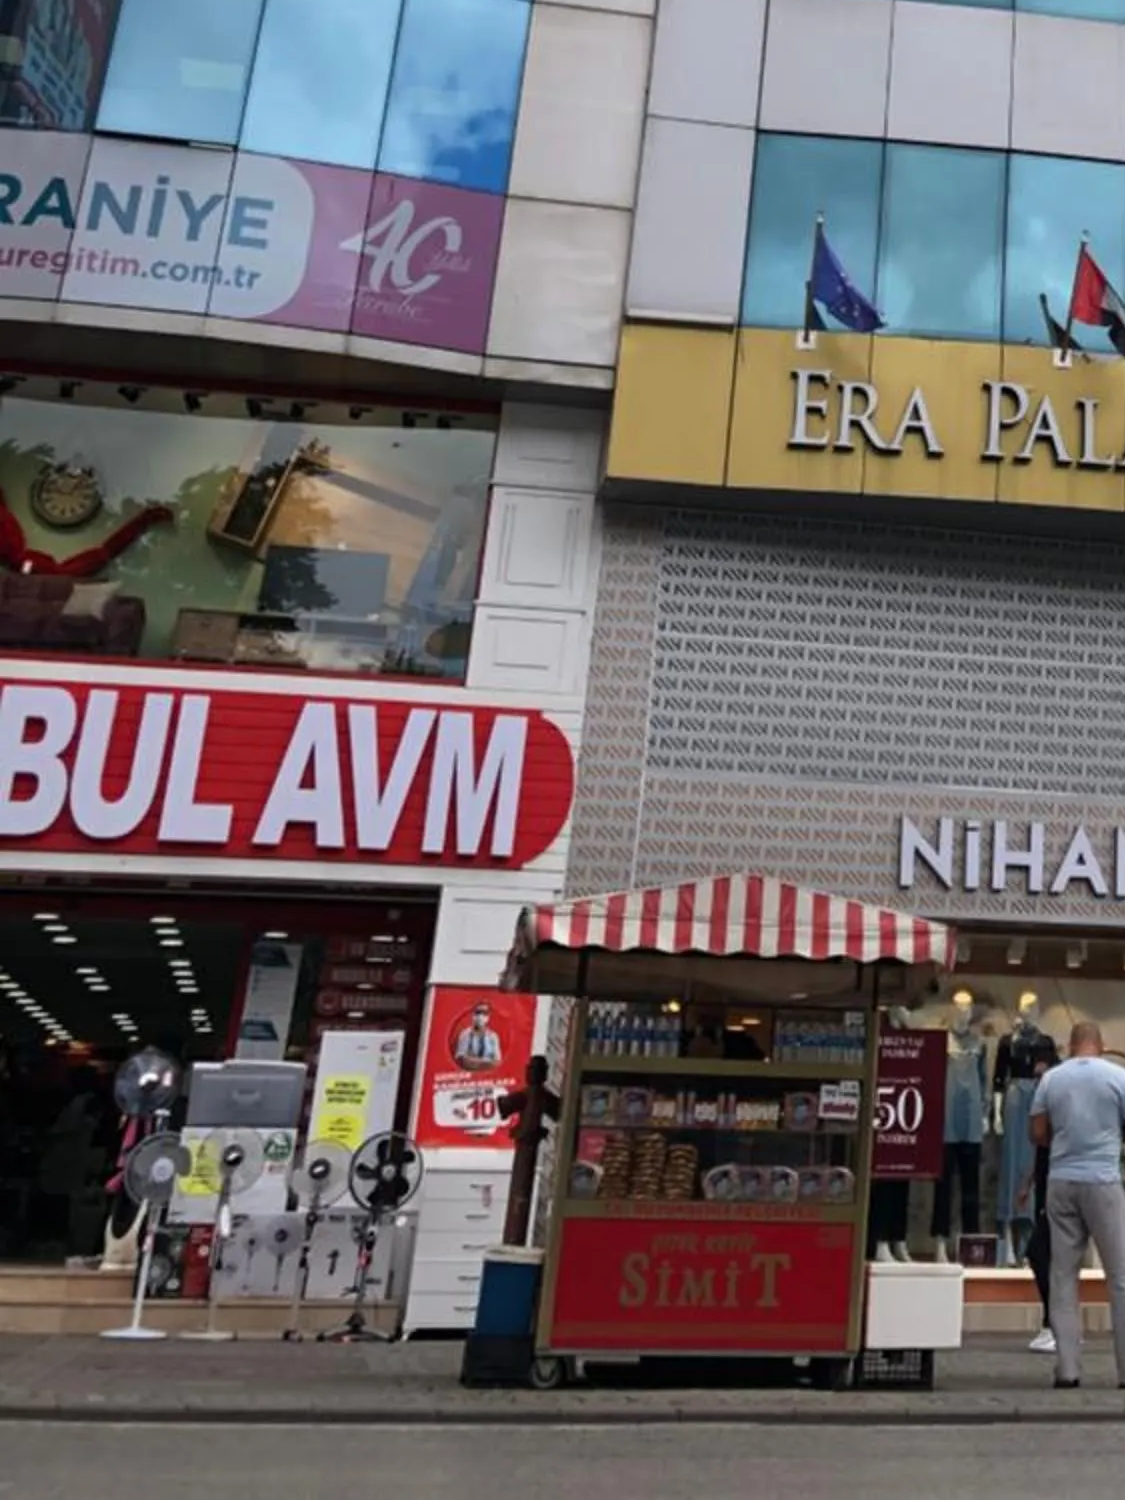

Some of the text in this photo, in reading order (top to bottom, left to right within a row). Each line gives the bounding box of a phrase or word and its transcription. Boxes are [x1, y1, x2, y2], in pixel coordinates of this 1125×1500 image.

[788, 369, 944, 457] ERA
[0, 684, 530, 860] BUL AVM
